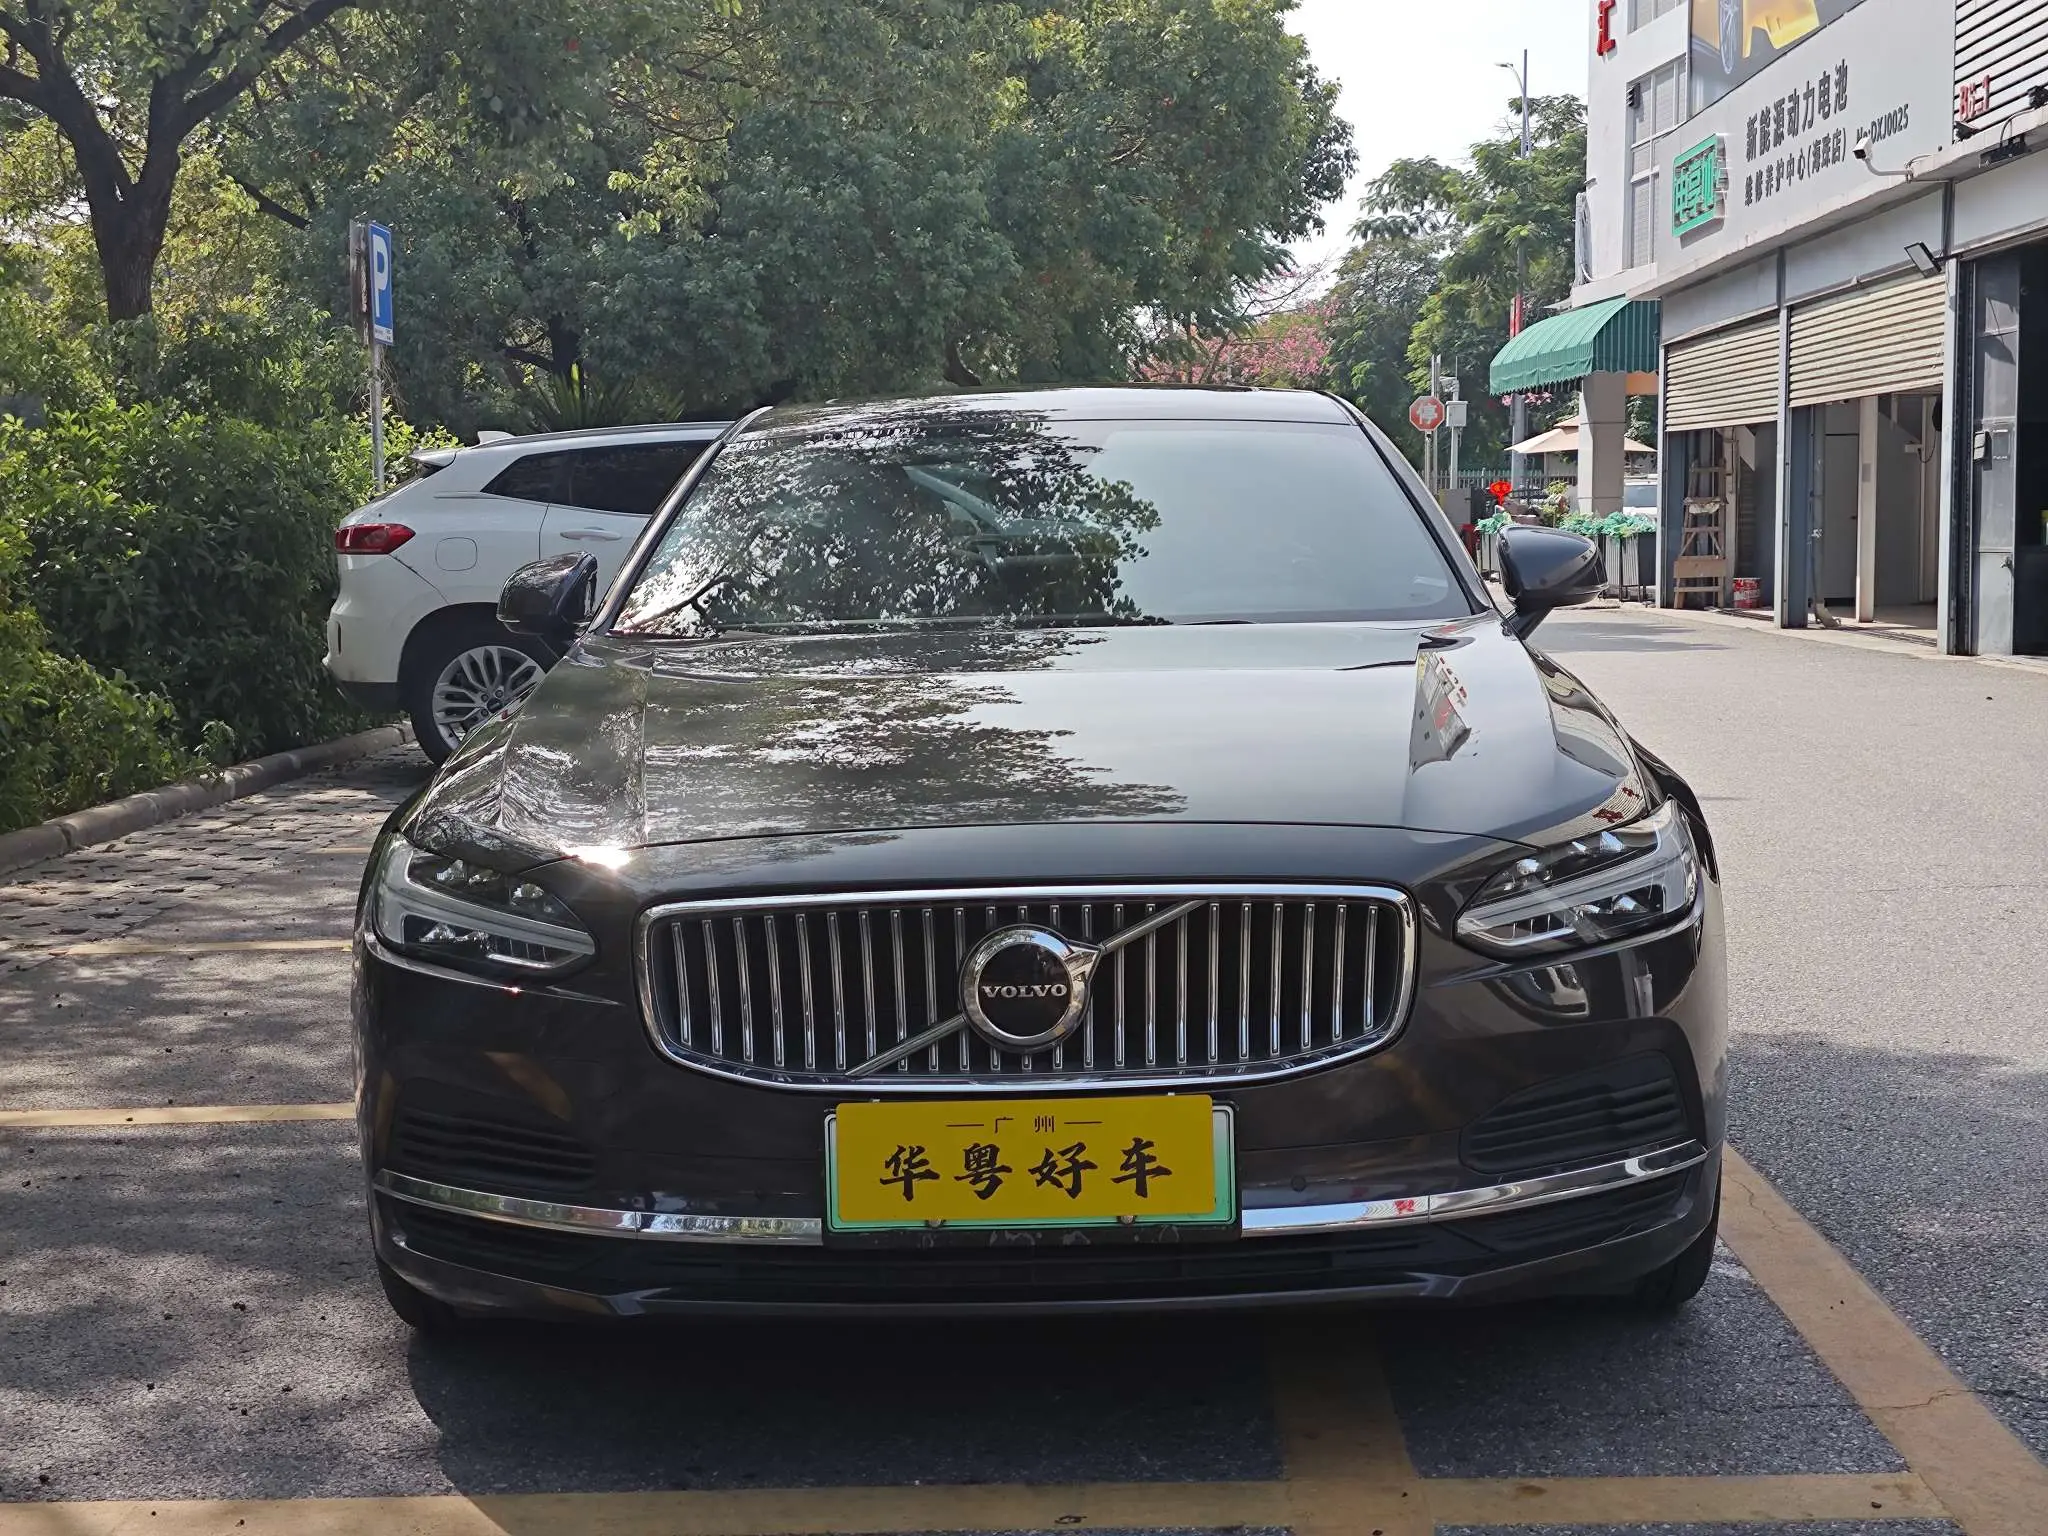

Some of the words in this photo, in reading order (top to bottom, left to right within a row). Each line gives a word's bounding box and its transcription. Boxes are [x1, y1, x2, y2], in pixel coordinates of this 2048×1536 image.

[1746, 59, 1848, 163] 新能源动力电池
[372, 233, 389, 318] P
[981, 984, 1068, 998] VOLVO
[994, 1115, 1056, 1134] 广州
[879, 1136, 1173, 1202] 华粤好车
